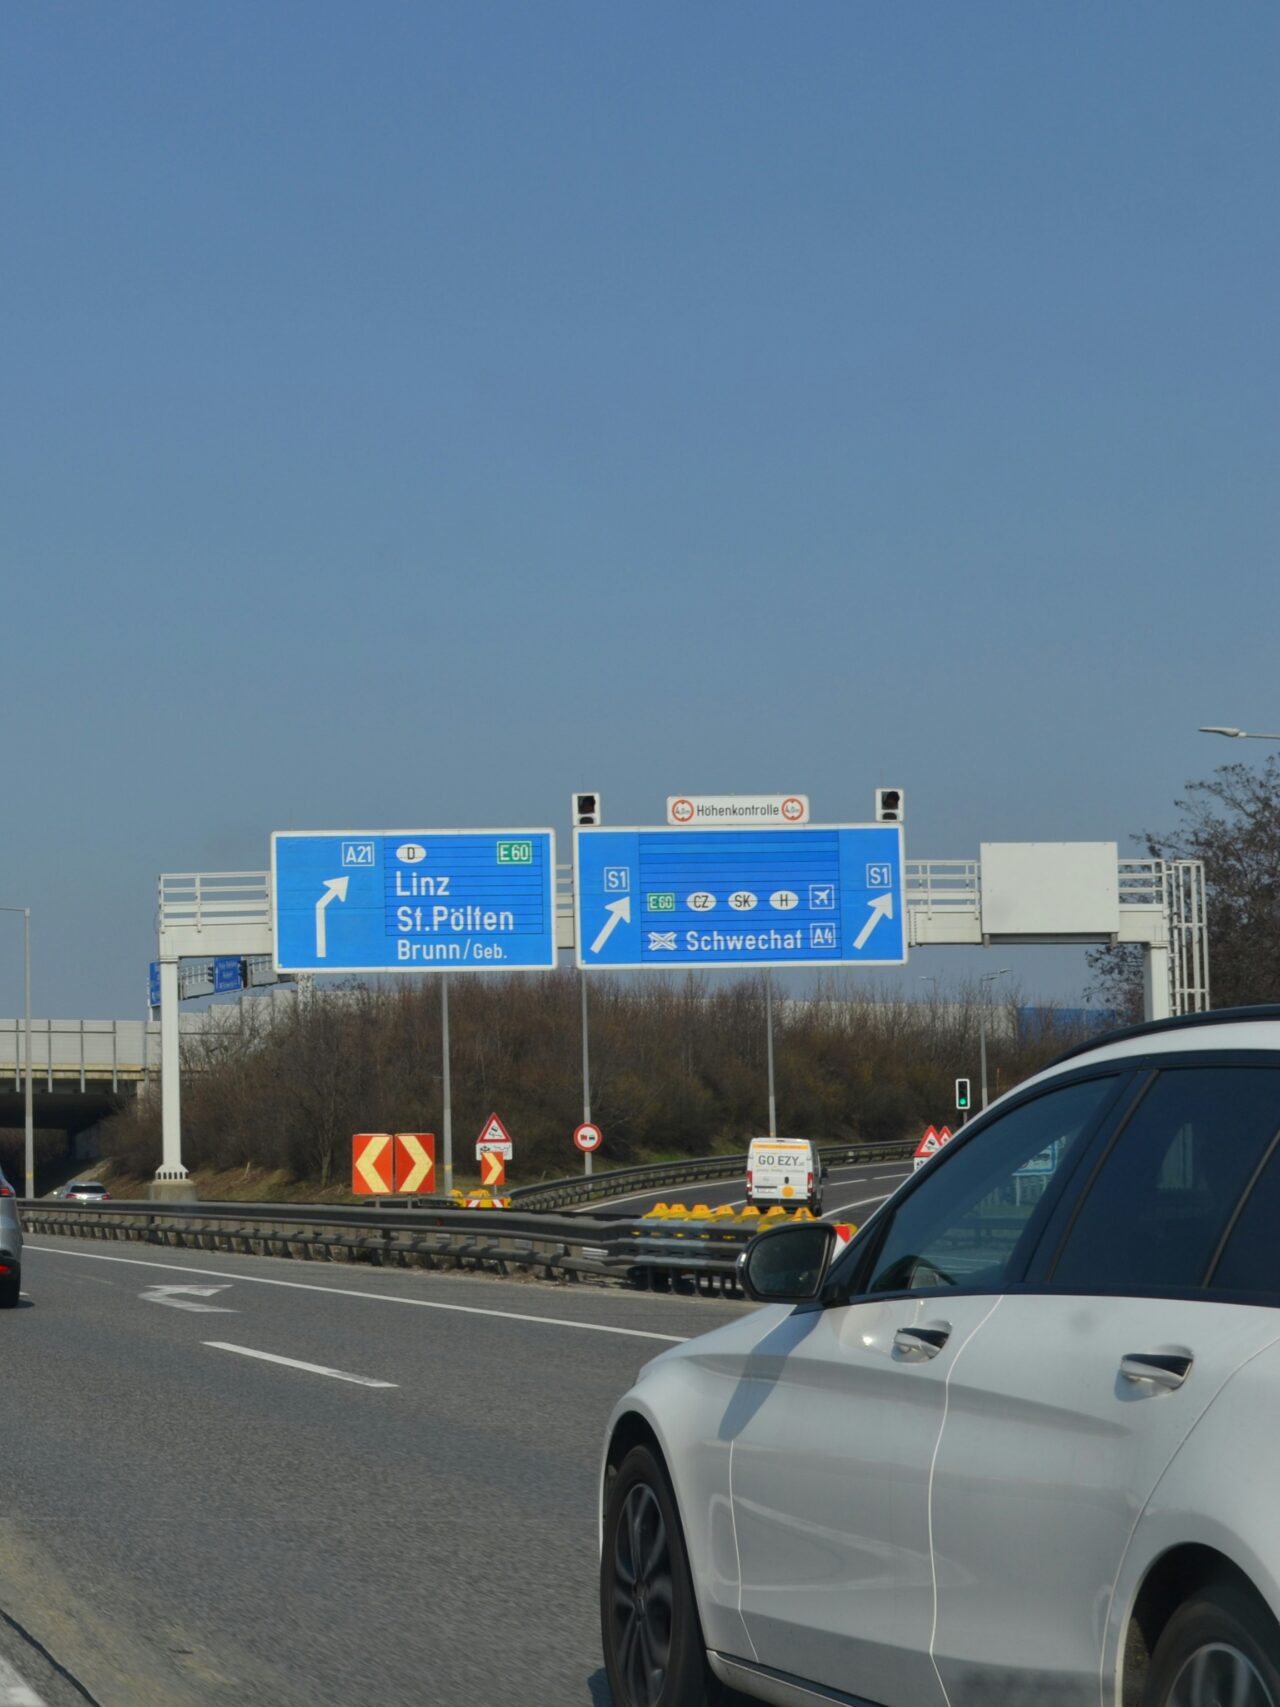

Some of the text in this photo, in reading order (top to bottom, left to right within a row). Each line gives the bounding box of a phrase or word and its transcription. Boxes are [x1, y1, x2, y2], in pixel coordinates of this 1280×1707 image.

[697, 804, 780, 817] Höhenkontrolle
[346, 847, 372, 863] A21
[407, 847, 416, 860] D
[500, 845, 529, 861] E60
[396, 871, 450, 896] Linz
[608, 872, 626, 888] S1
[870, 868, 889, 884] S1
[693, 896, 709, 909] CZ
[734, 895, 751, 908] SK
[780, 895, 788, 908] H
[397, 906, 514, 932] St.Pölten
[686, 930, 802, 951] Schwechat
[813, 927, 833, 945] A4
[758, 1155, 775, 1166] GO
